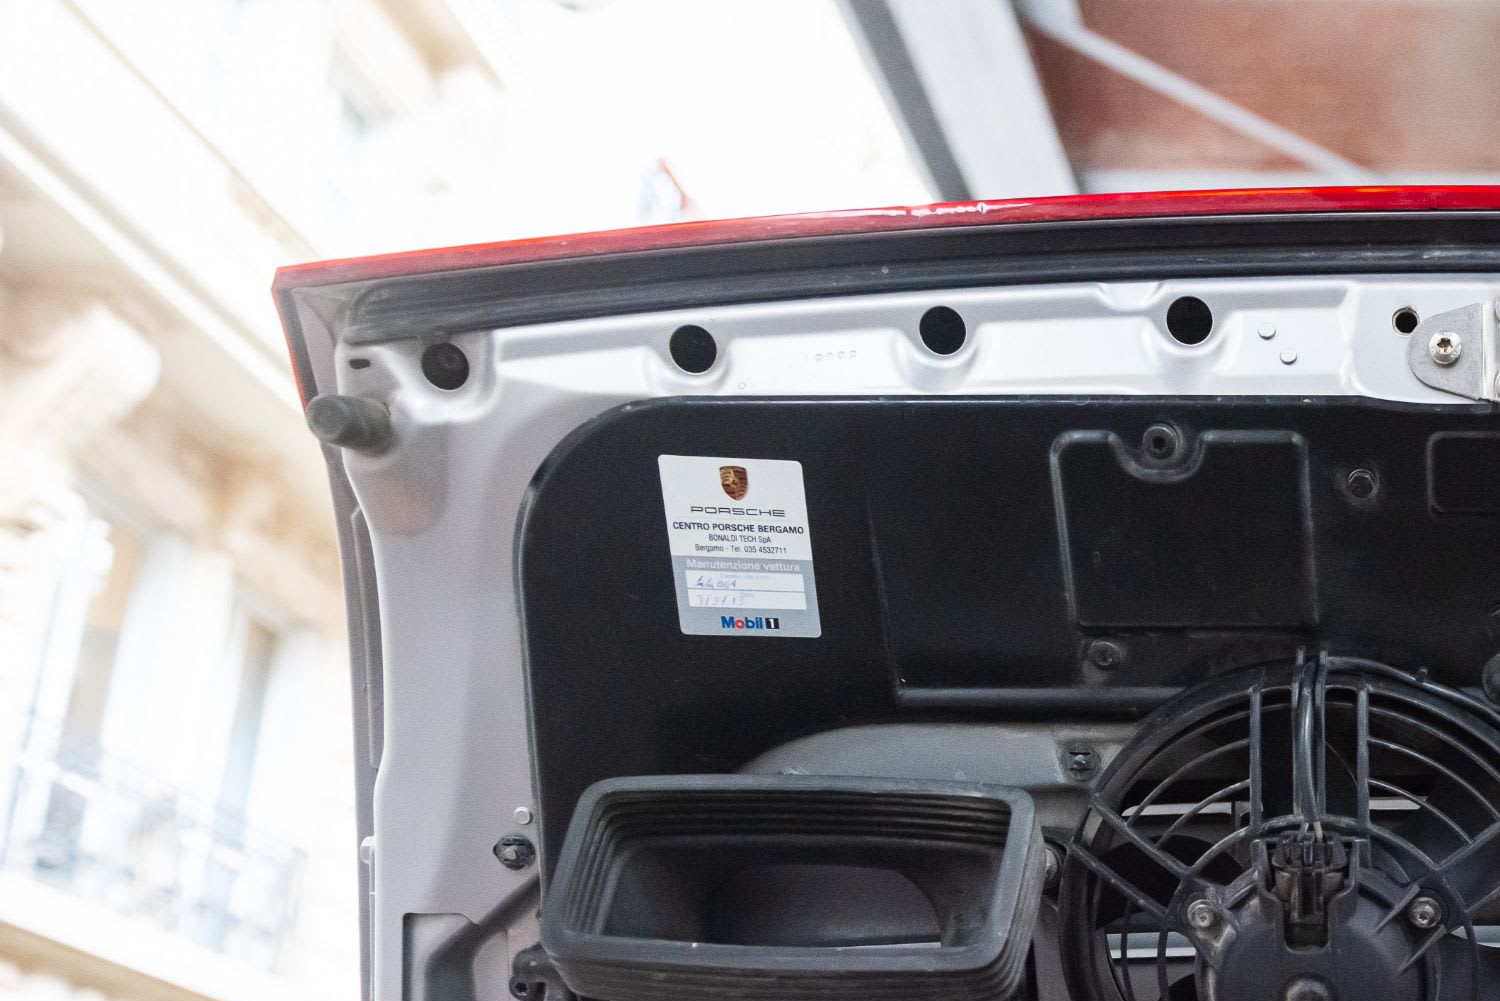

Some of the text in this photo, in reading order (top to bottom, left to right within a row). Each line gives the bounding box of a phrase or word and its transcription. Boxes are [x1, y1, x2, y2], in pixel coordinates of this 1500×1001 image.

[690, 505, 786, 517] PORSCHE
[672, 521, 804, 534] CENTRO PORSCHE BERGAMO
[708, 533, 772, 544] BONALDI TECH SpA
[695, 544, 724, 553] Bergamo
[686, 558, 800, 572] Manutenzione vettura
[721, 615, 764, 629] Mobil
